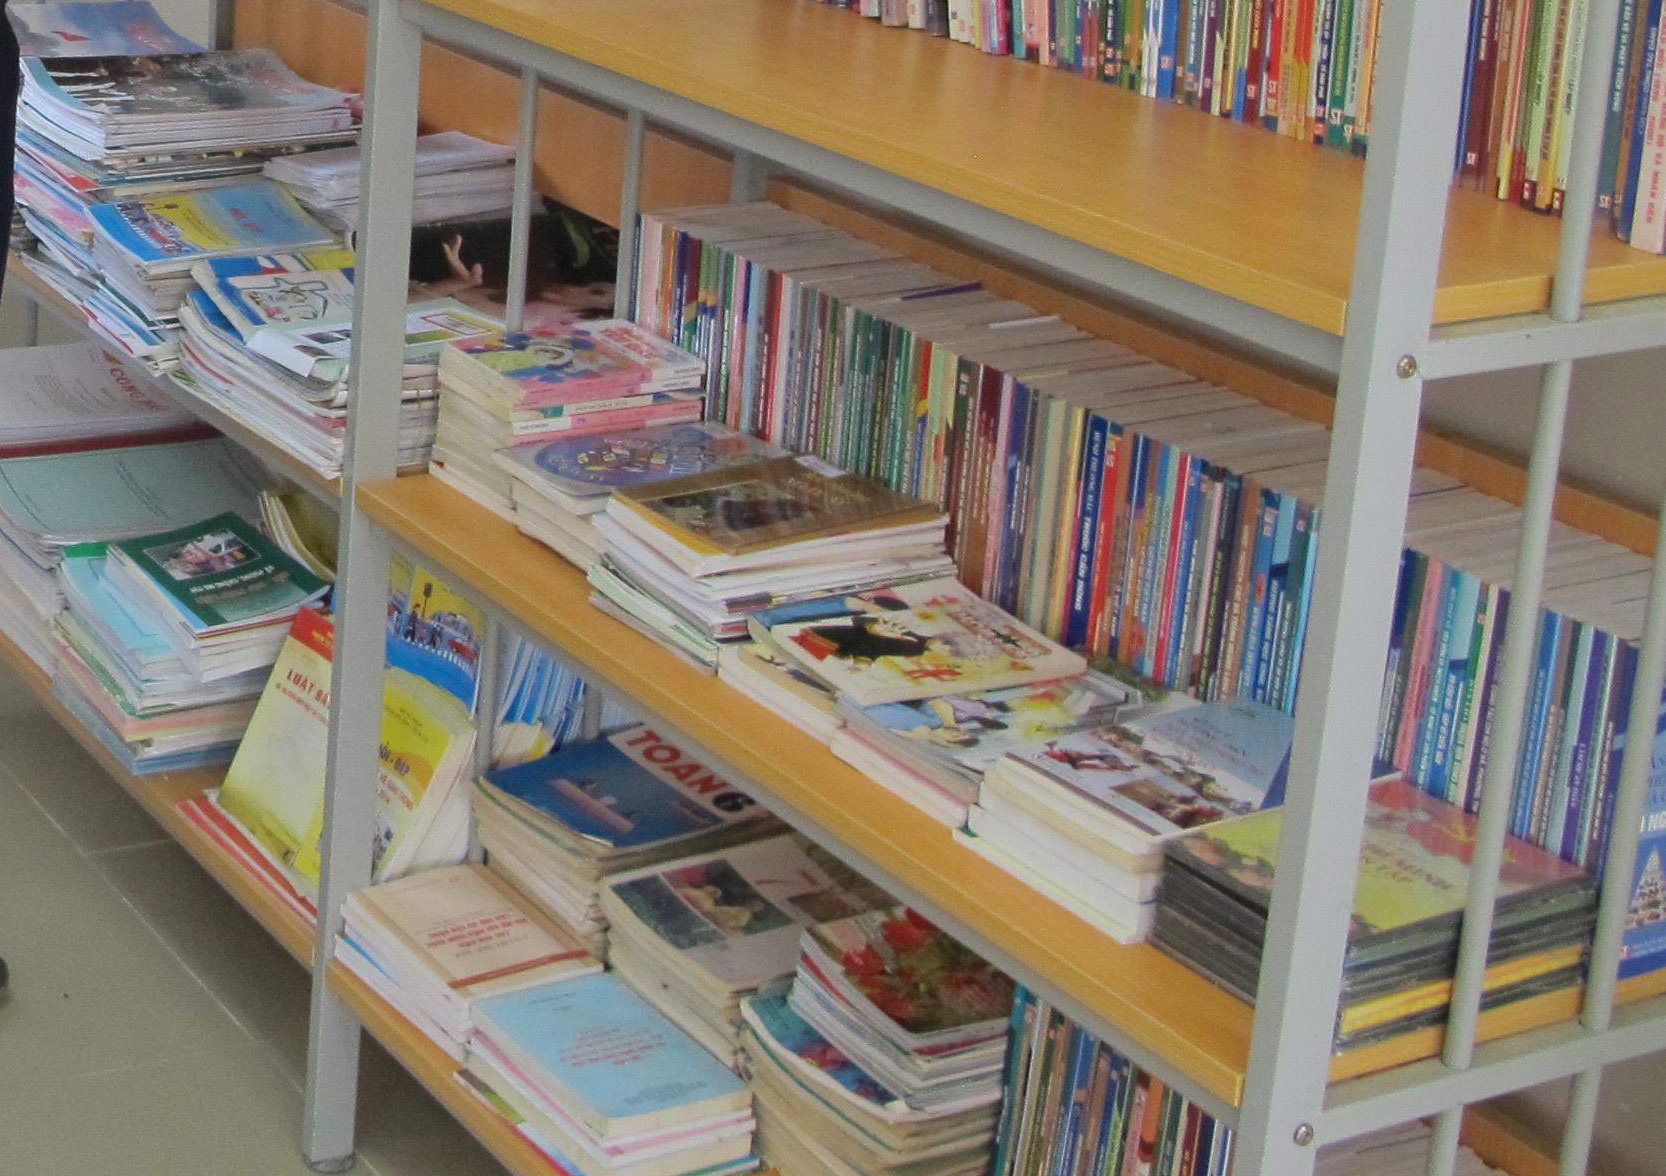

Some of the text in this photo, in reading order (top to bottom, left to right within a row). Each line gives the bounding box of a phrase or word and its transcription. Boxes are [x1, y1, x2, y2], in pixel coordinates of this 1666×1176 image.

[1080, 516, 1093, 552] THUỐC
[1077, 553, 1088, 577] CẦN
[1073, 578, 1085, 610] DÙNG
[712, 792, 757, 813] 6
